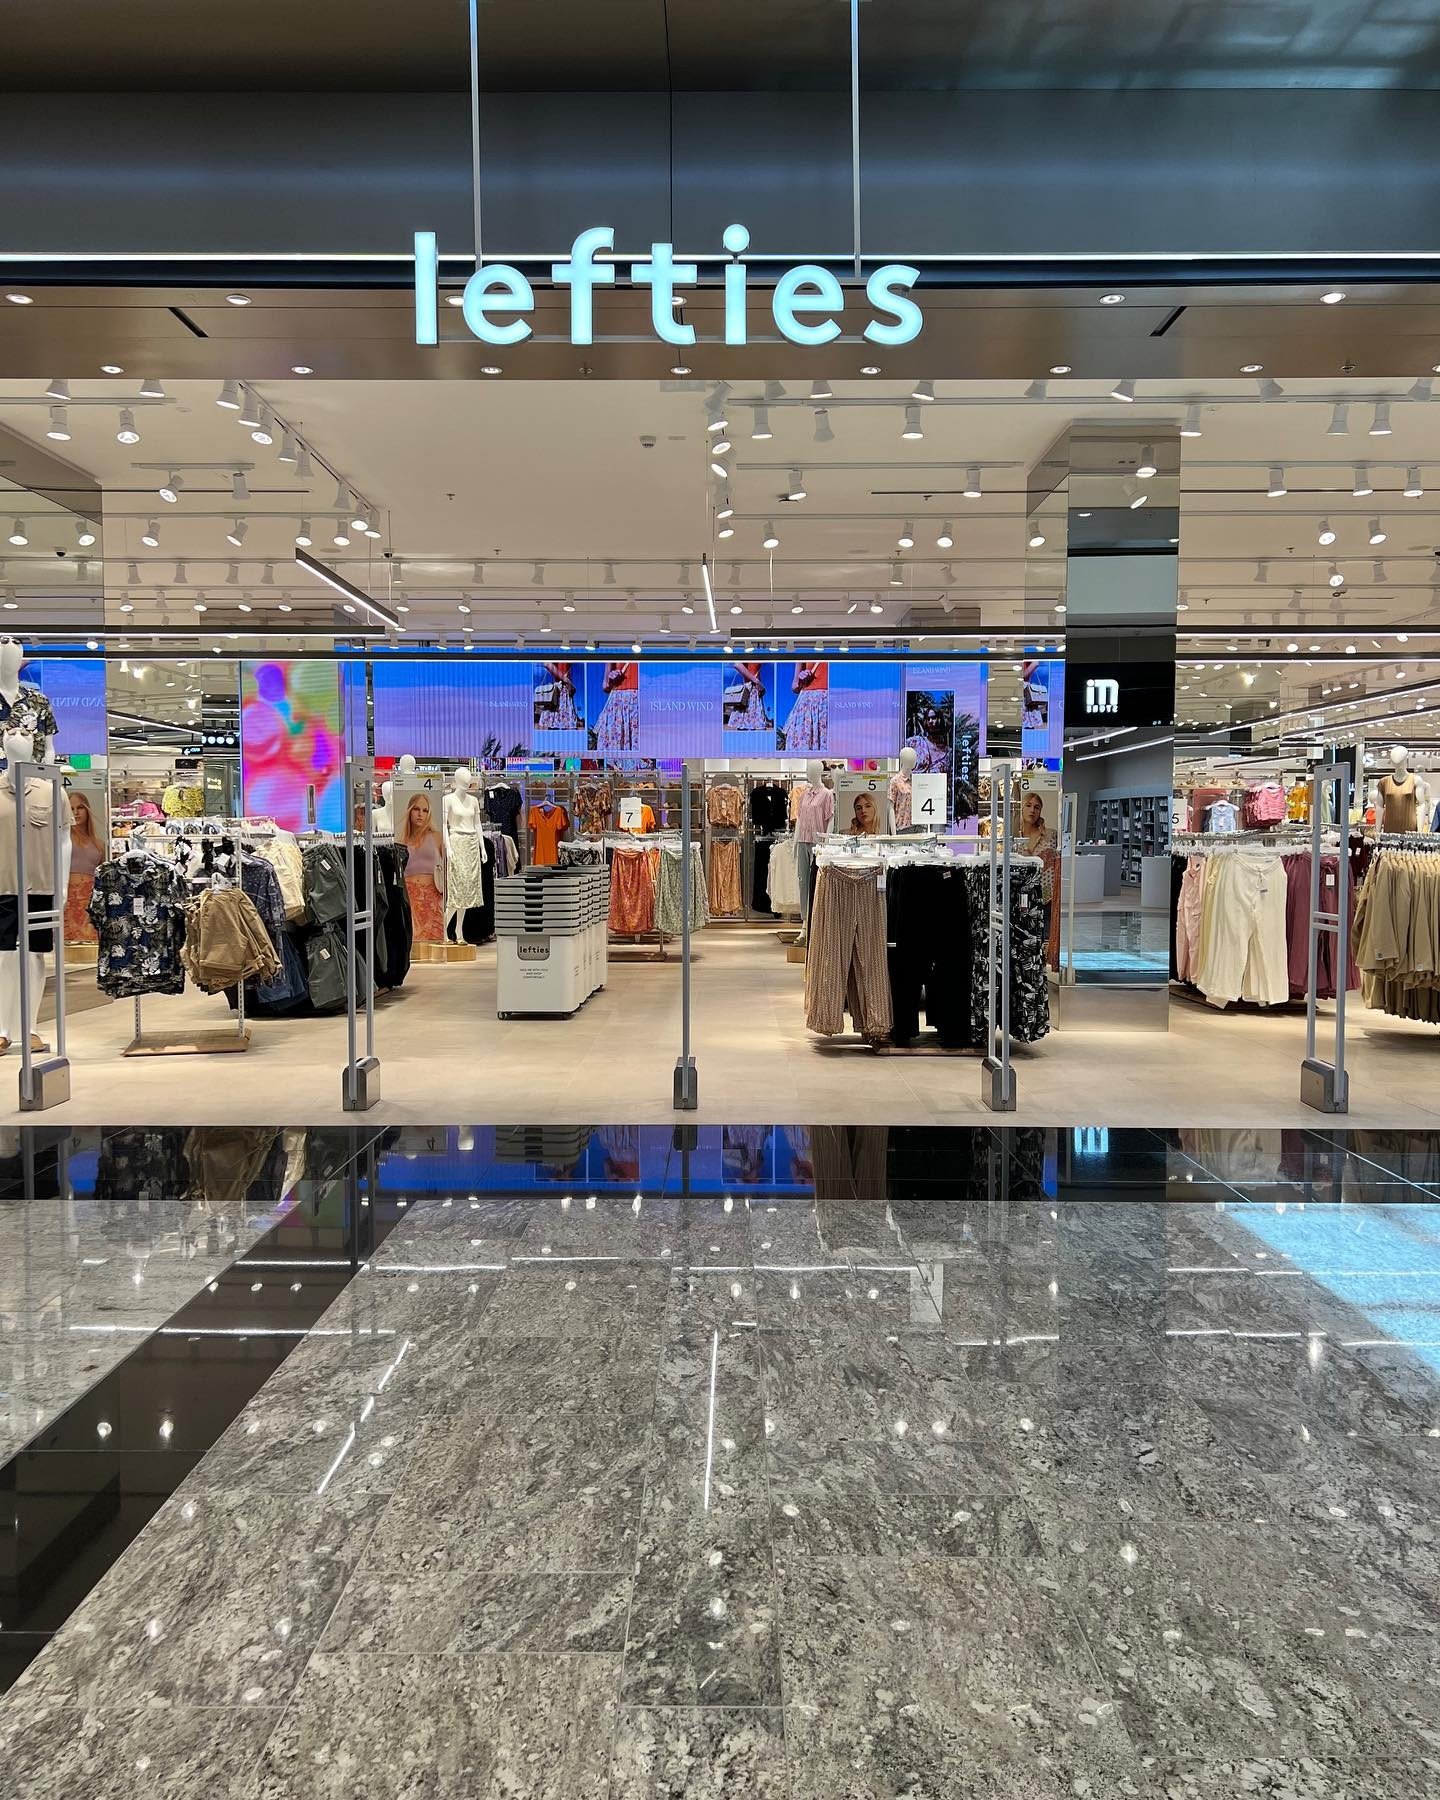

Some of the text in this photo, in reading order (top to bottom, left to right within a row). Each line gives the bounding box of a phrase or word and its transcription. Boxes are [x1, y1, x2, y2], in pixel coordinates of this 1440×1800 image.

[414, 224, 924, 346] lefties
[650, 701, 714, 711] ISLAND WIND
[961, 735, 972, 780] lefties
[423, 778, 433, 790] 4
[867, 780, 877, 791] 5
[920, 798, 936, 816] 4
[625, 812, 634, 823] 7
[1171, 813, 1180, 824] 5
[519, 945, 550, 953] lefties
